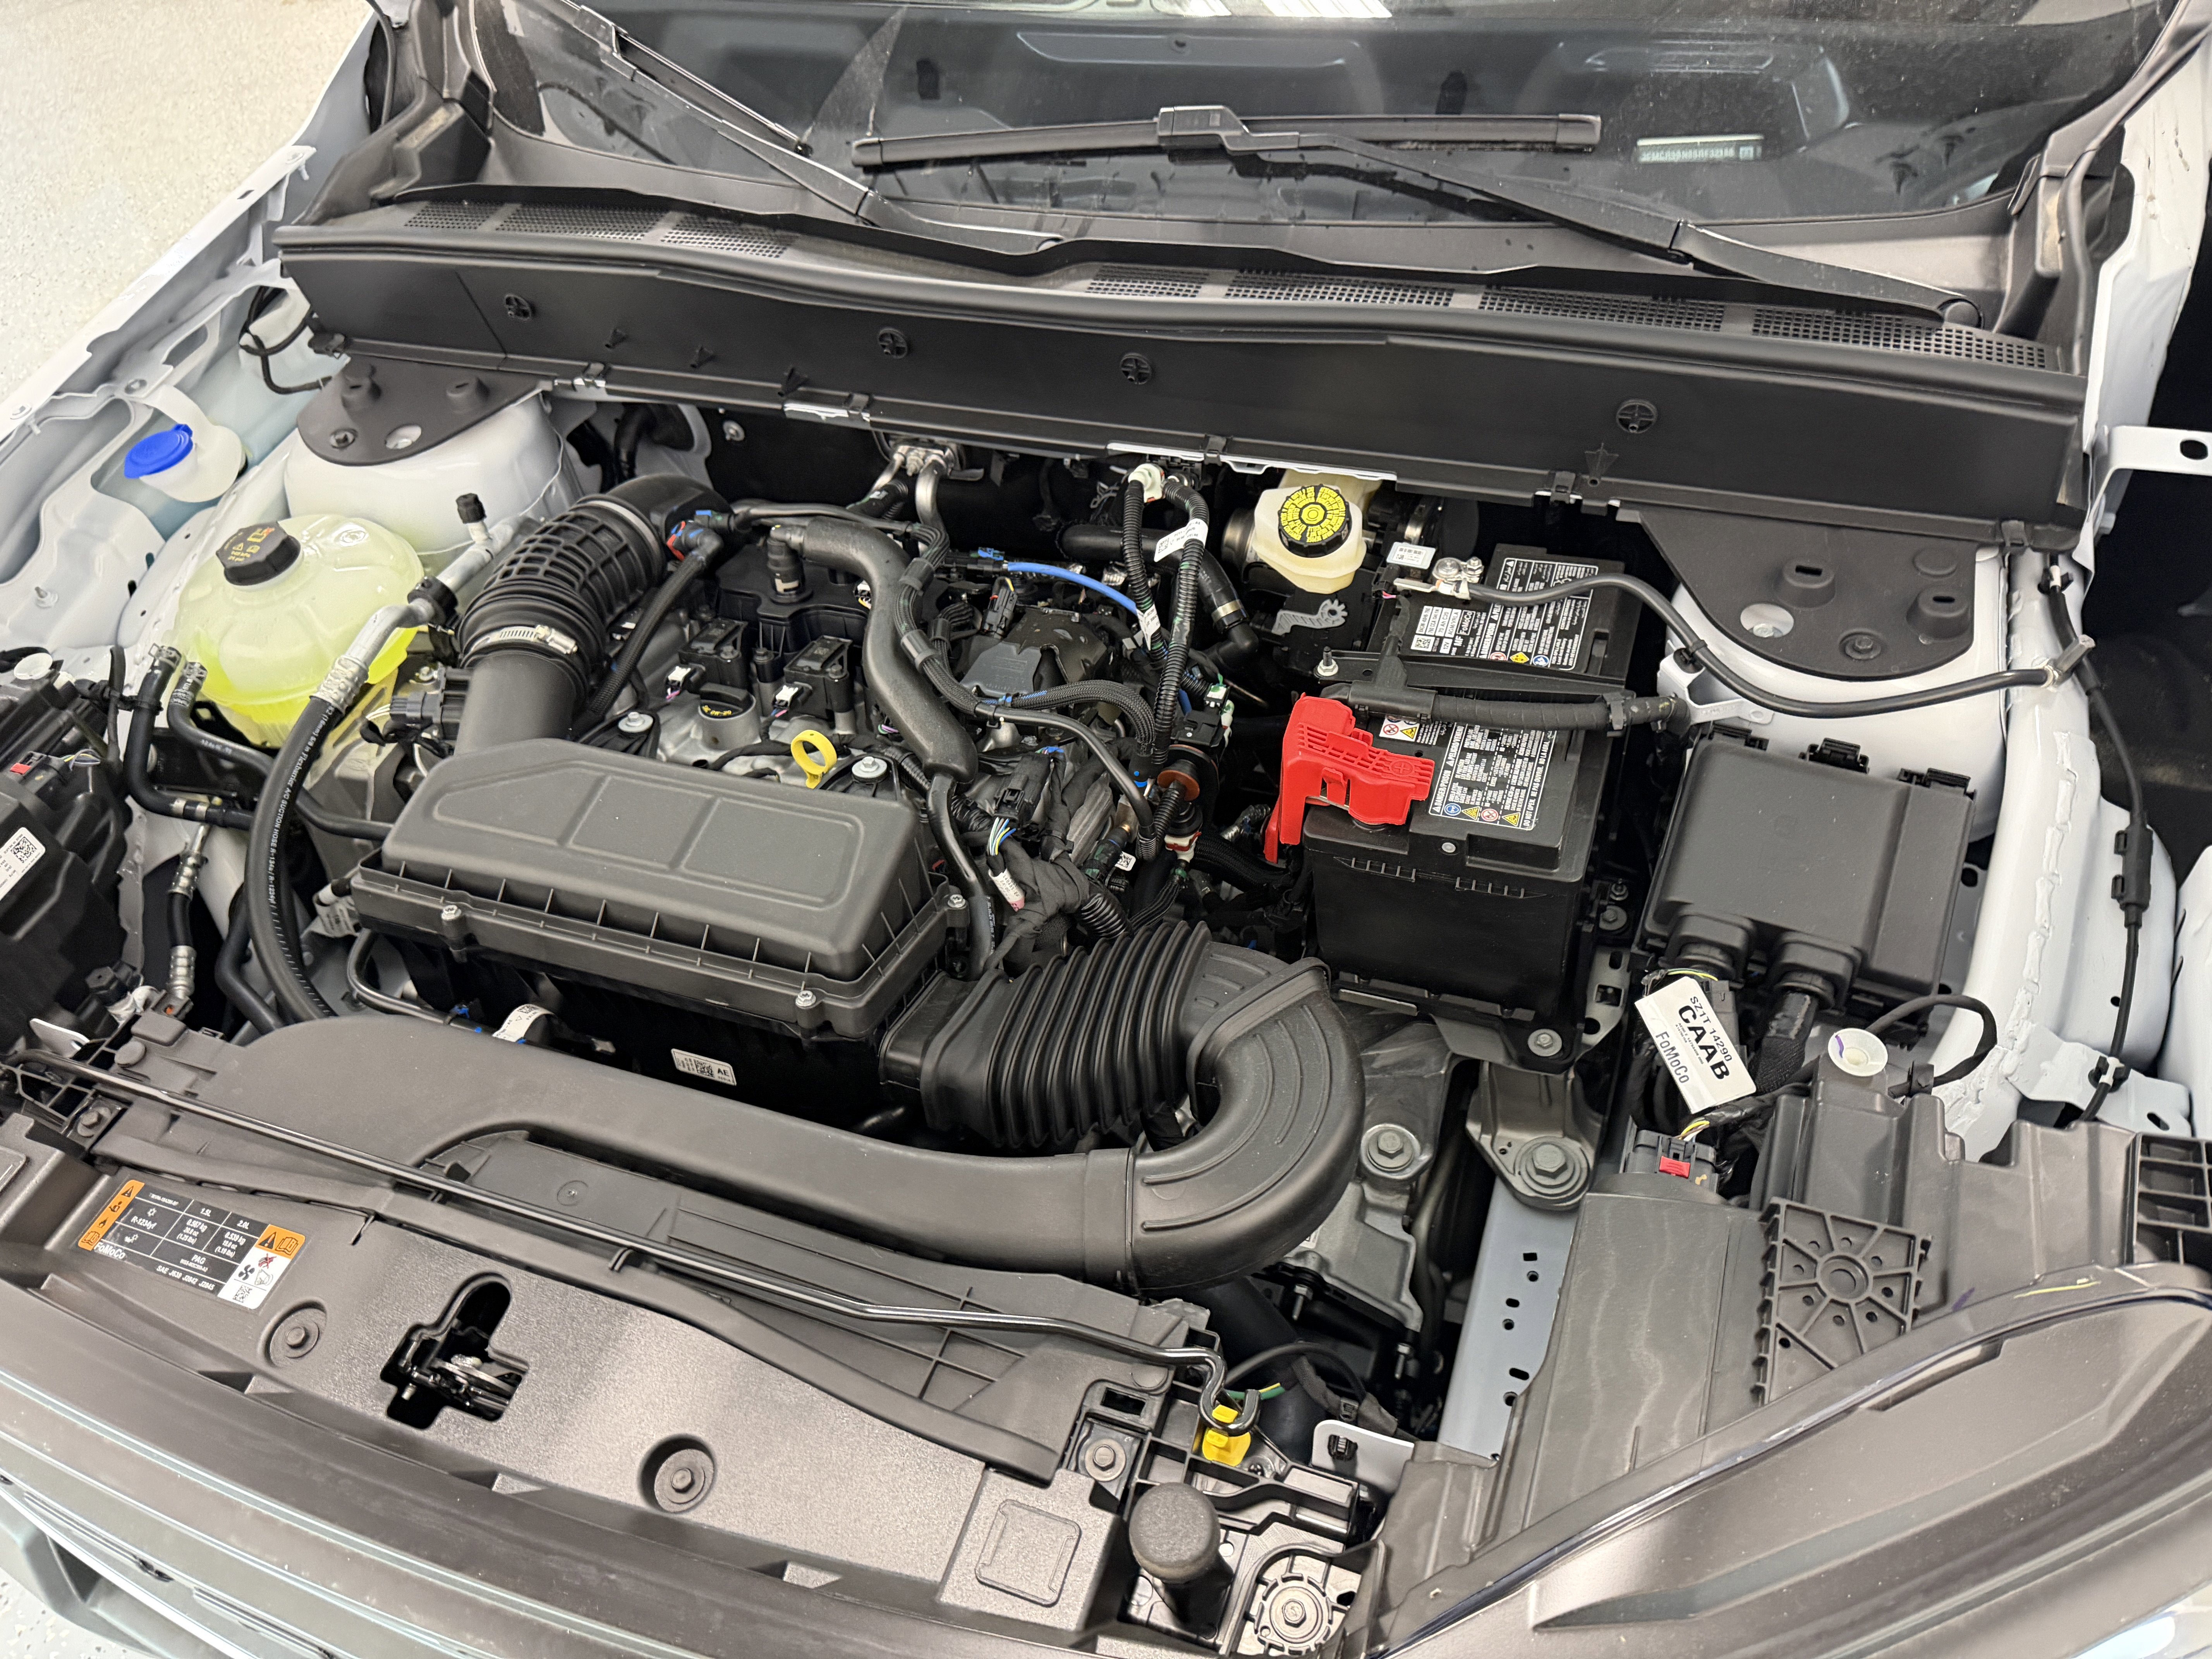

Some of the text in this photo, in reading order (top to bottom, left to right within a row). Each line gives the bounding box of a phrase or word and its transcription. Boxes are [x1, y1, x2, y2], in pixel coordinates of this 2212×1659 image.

[1448, 612, 1458, 635] AGM/VRLA
[1460, 611, 1472, 633] FoMoCo
[1453, 635, 1463, 646] MF
[1448, 726, 1463, 760] PELIGRO/VENENO
[287, 752, 308, 787] Flexbarrier
[1527, 799, 1535, 811] OPEN.
[1534, 766, 1543, 782] OUVRIR.
[1541, 740, 1550, 752] ABRA.
[283, 787, 292, 800] A/C
[1434, 770, 1451, 806] DANGER/POISON
[275, 799, 287, 829] SUCTION
[271, 828, 280, 848] HOSE
[1690, 996, 1732, 1061] SZ1T 14290
[1679, 1006, 1729, 1079] CAAB
[1656, 1031, 1689, 1083] FoMoCo
[200, 1208, 211, 1216] 1.5L
[131, 1216, 156, 1229] R-1234yf
[199, 1223, 207, 1232] kg
[237, 1220, 249, 1229] 2.0L
[94, 1242, 125, 1259] FoMoCo
[237, 1236, 246, 1245] kg
[191, 1254, 206, 1264] PAG
[156, 1265, 169, 1274] SAE
